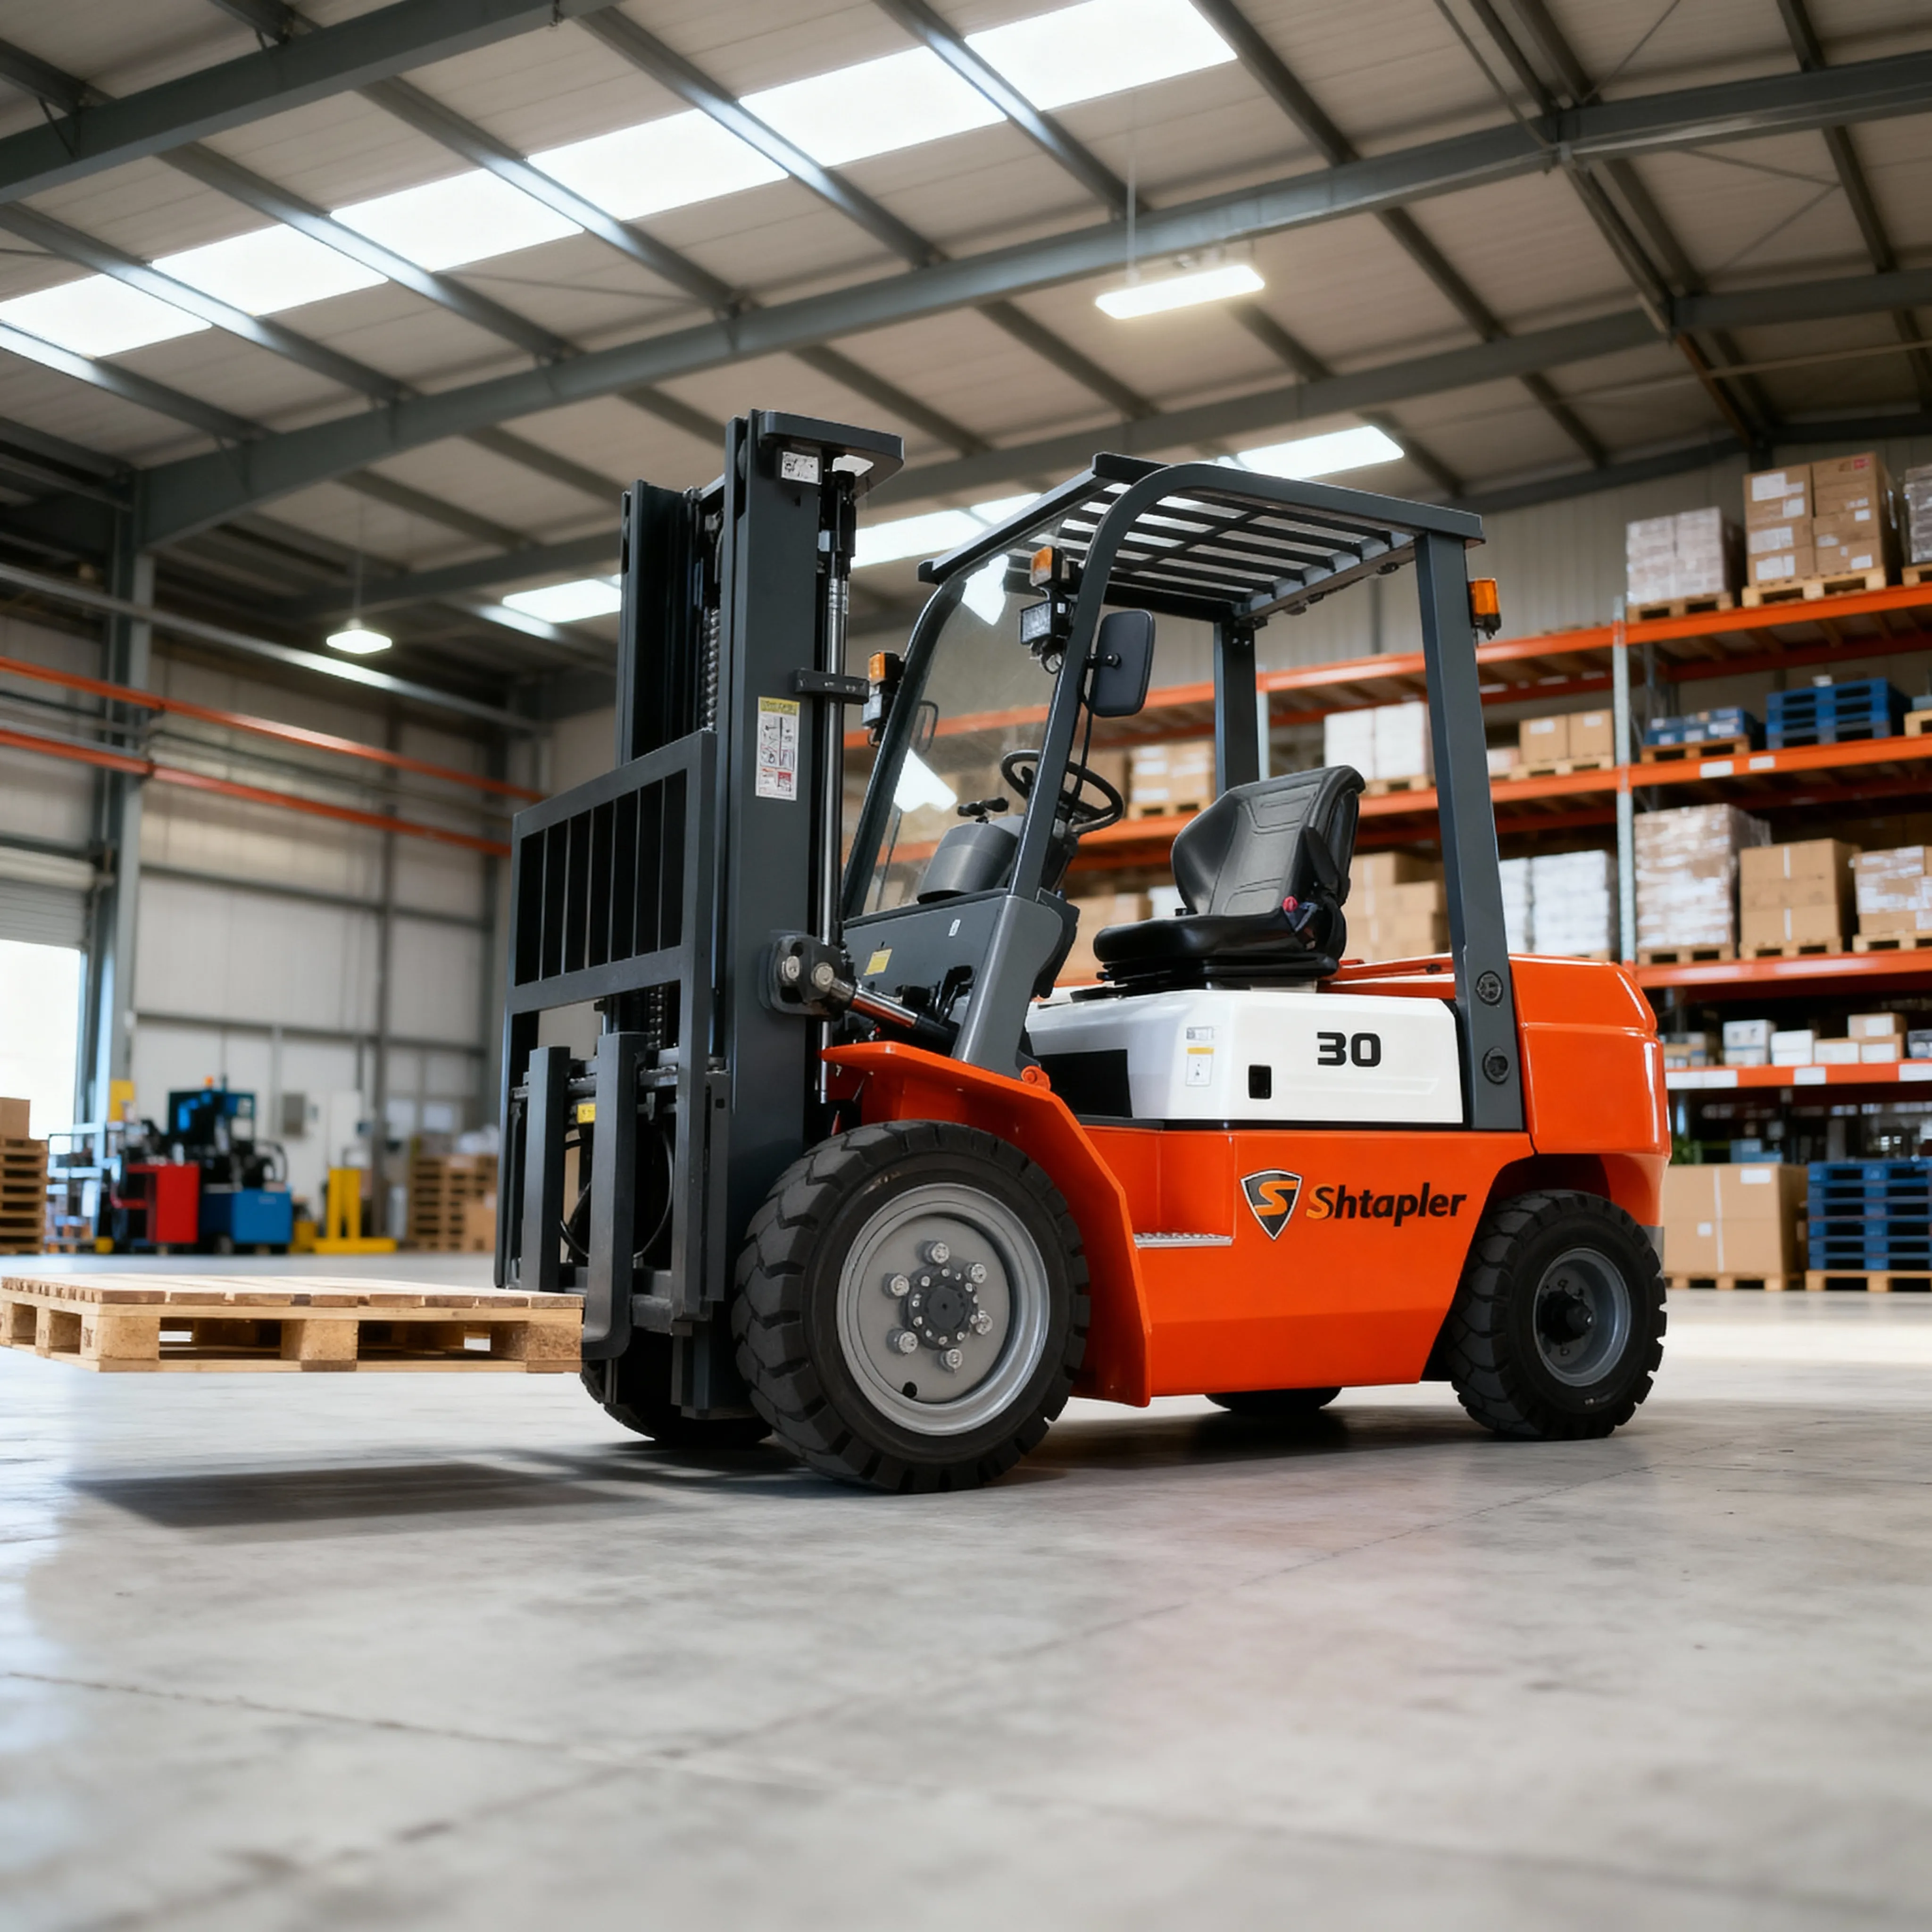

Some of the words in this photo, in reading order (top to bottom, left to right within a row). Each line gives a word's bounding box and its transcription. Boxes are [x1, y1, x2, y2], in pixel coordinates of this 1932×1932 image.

[1317, 1032, 1381, 1067] 30
[1253, 1180, 1298, 1216] S
[1306, 1183, 1467, 1226] Shtapler
